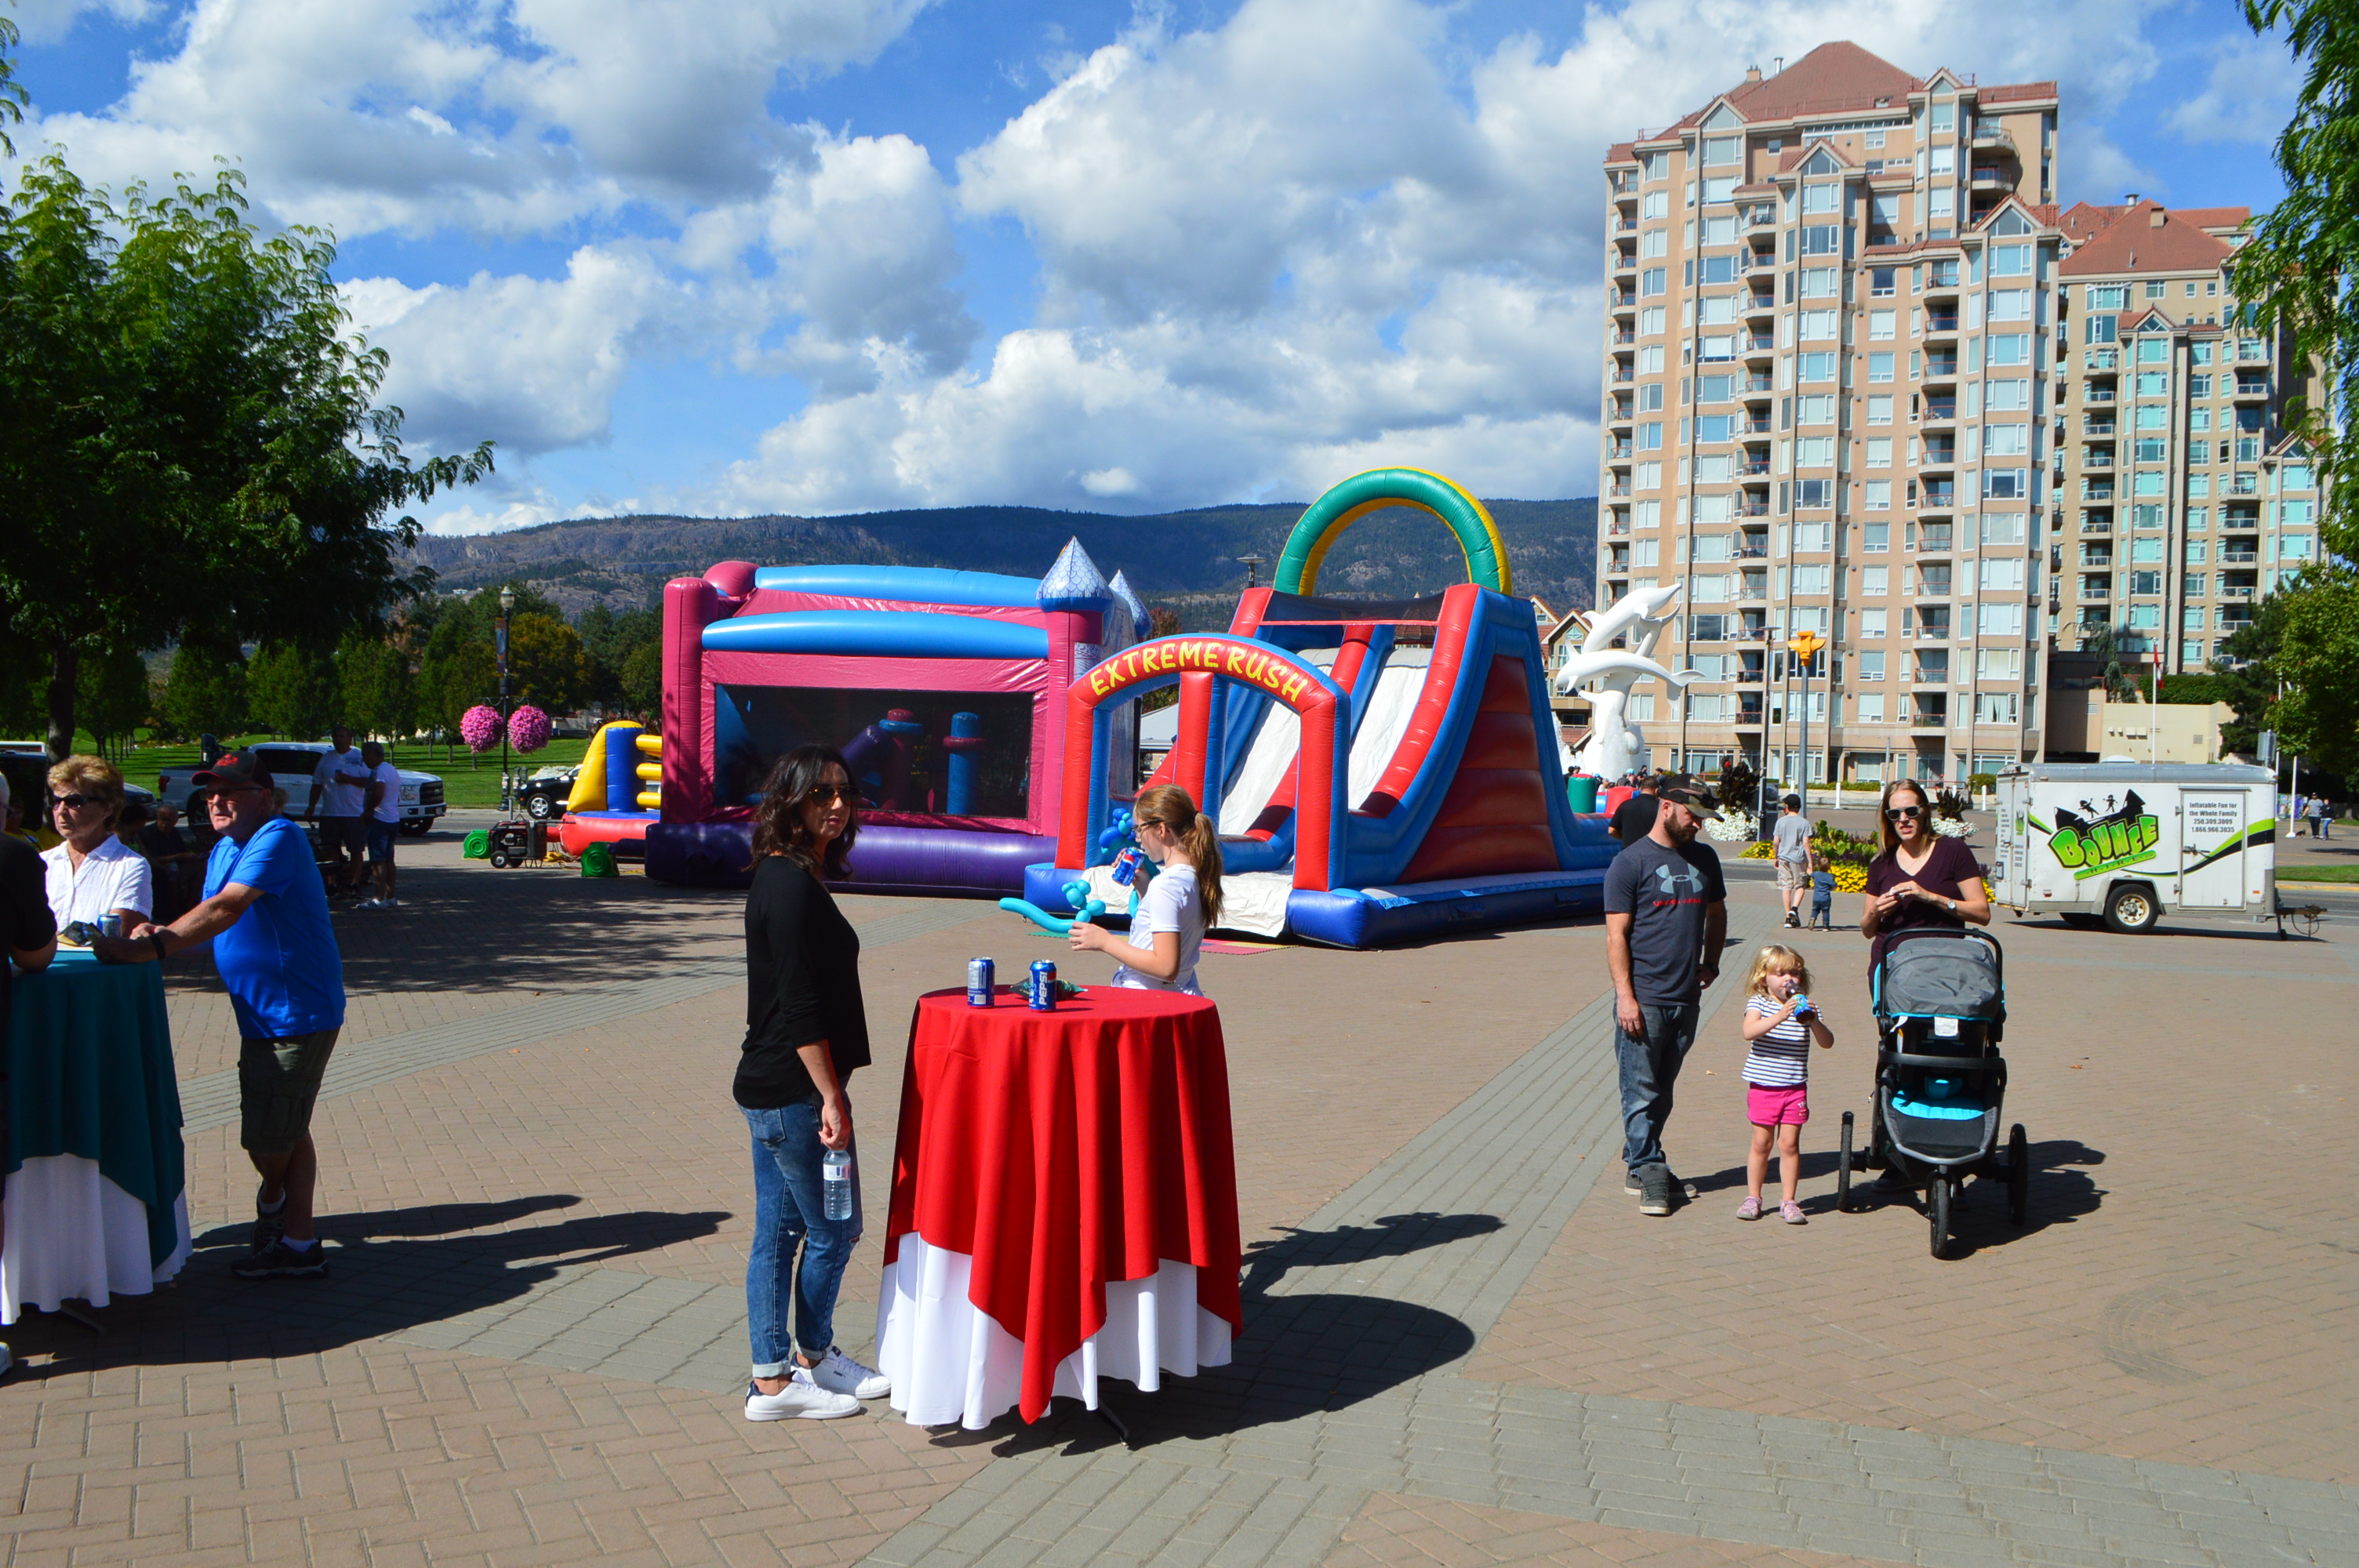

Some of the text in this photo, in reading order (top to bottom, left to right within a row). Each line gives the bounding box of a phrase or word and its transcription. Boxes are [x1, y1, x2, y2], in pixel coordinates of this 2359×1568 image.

[1090, 641, 1308, 702] EXTREME RUSH
[1039, 971, 1048, 1005] PEPSI
